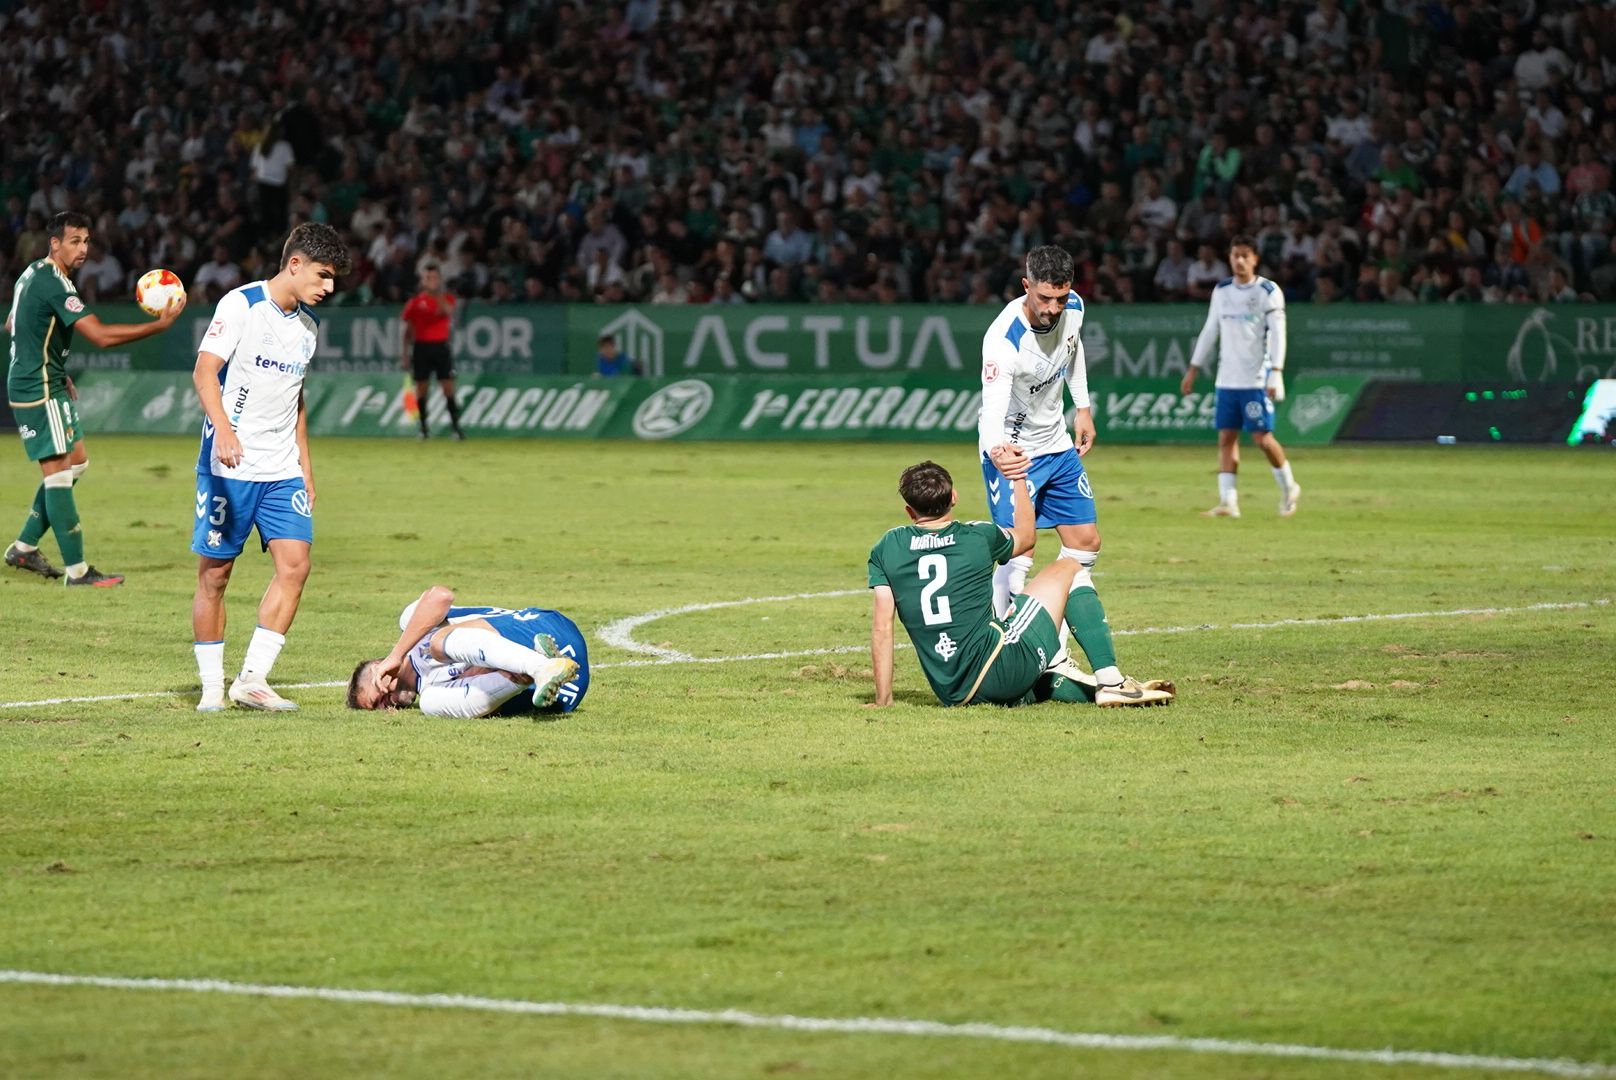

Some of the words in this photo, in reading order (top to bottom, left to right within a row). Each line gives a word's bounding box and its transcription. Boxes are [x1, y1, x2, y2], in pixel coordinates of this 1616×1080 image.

[684, 315, 963, 369] ACTUA
[209, 496, 228, 526] 3
[918, 554, 953, 626] 2
